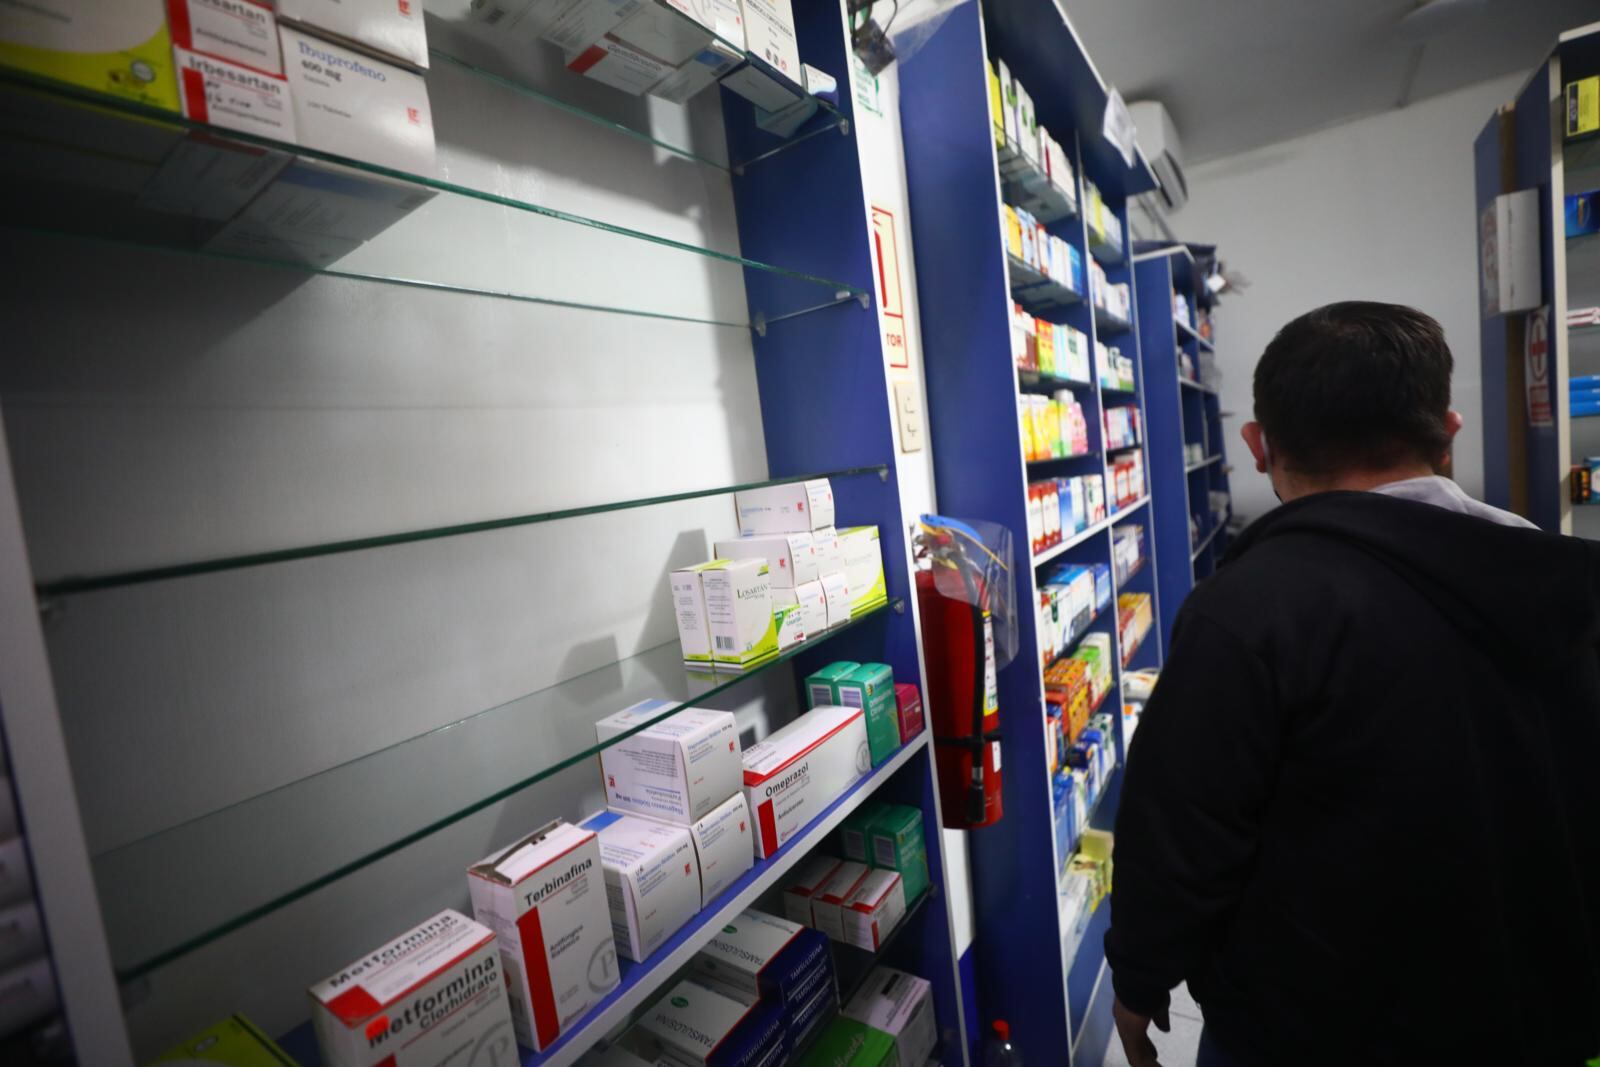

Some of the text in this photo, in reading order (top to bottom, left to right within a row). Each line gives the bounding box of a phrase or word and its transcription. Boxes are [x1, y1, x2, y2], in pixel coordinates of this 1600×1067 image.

[189, 56, 281, 94] Irbesartan
[298, 41, 387, 82] Ibuprofeno
[765, 762, 809, 797] Omeprazol
[524, 857, 593, 907] Terbinafina
[330, 915, 452, 988] Metformina
[419, 971, 498, 1029] Clorhidrato
